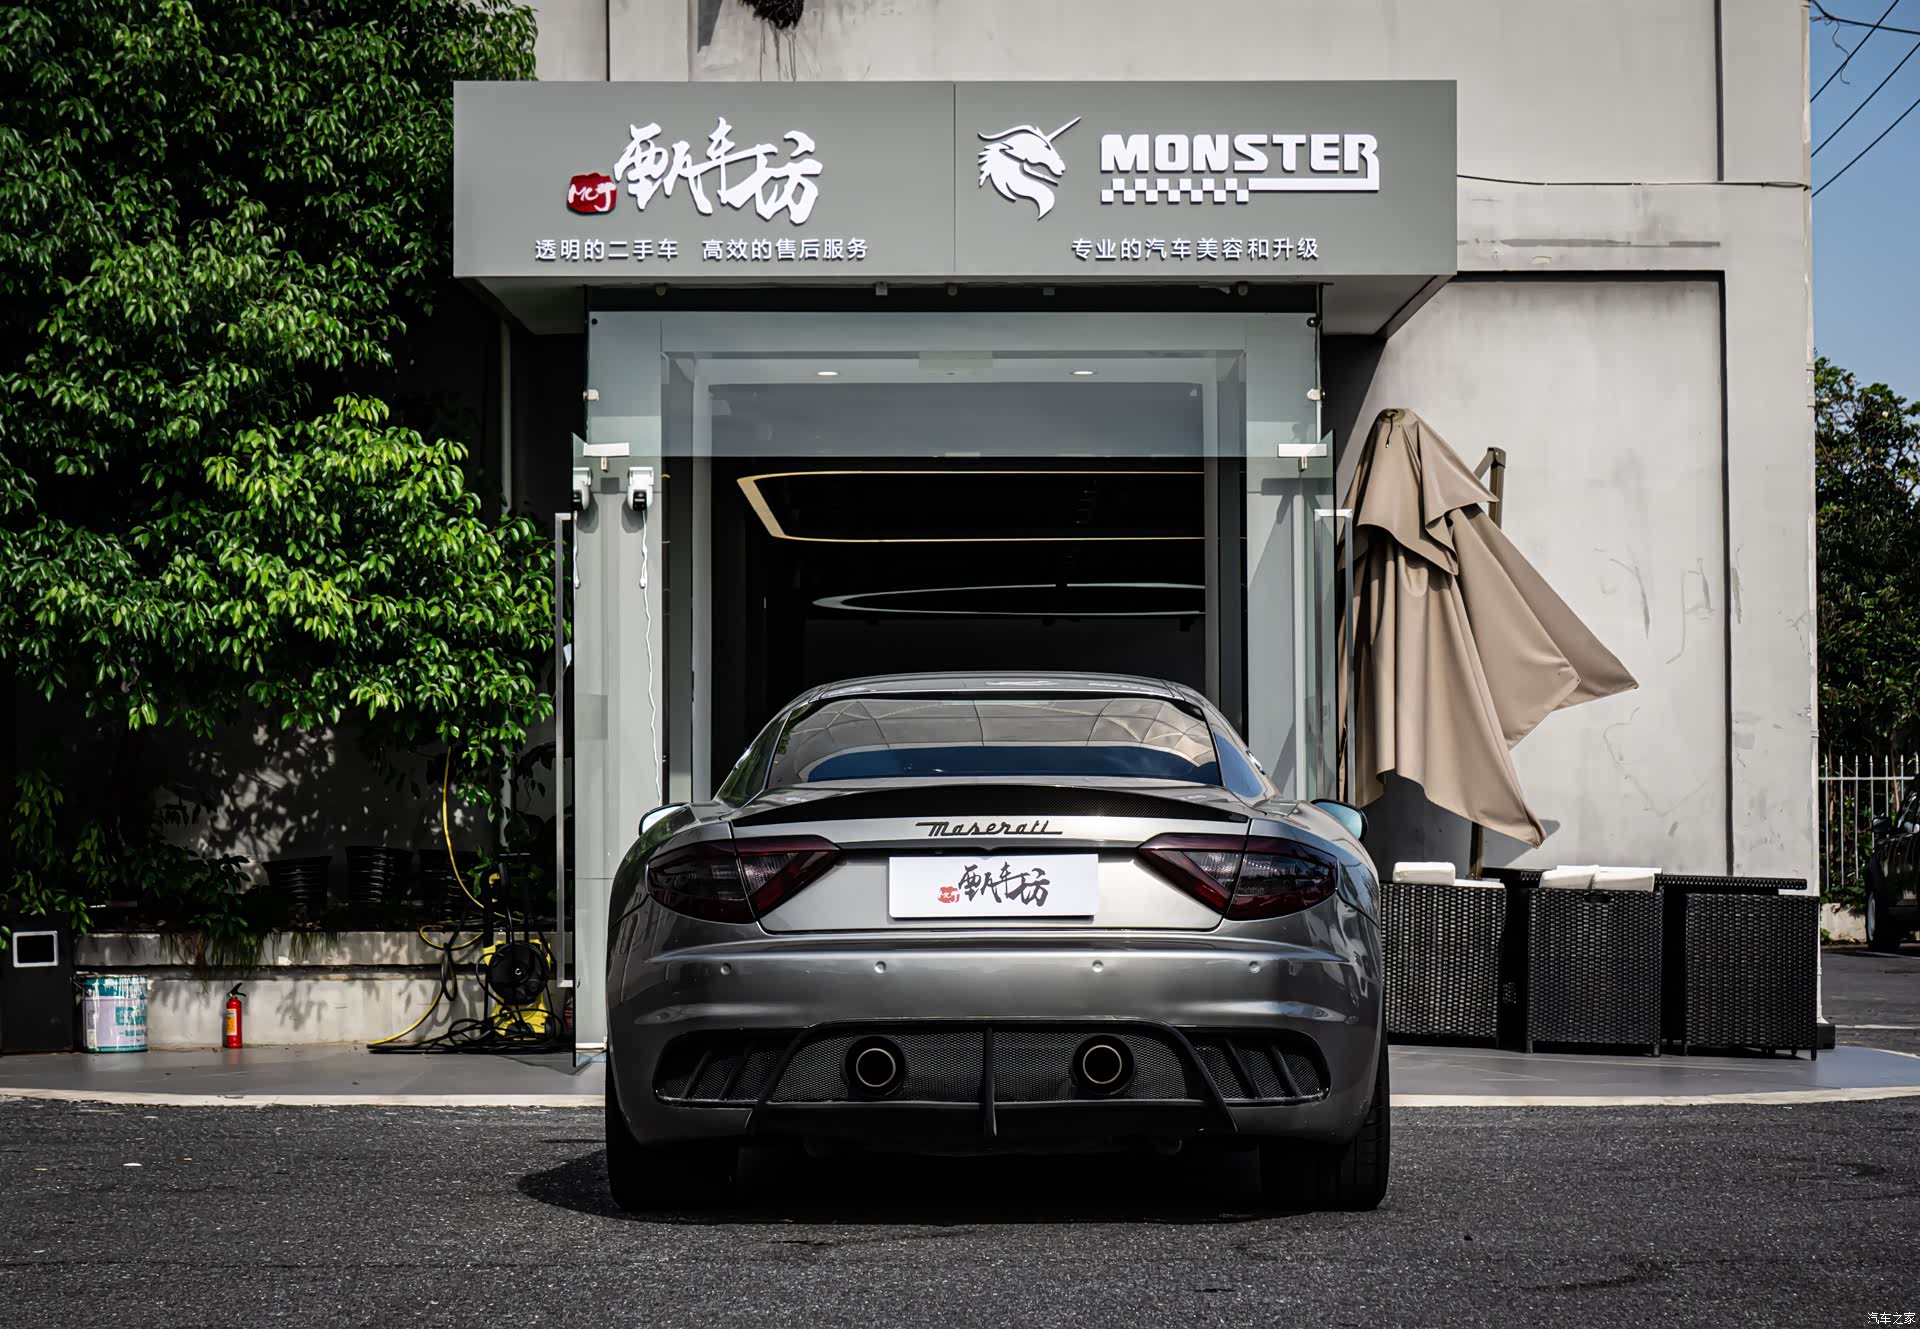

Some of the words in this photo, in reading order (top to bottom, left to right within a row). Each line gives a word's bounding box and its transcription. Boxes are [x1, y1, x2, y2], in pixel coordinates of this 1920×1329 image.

[1102, 134, 1380, 191] MONSTER
[535, 237, 679, 260] 透明的二手车
[702, 236, 869, 260] 高效的售后服务
[1071, 236, 1319, 260] 专业的汽车美容和升级
[915, 820, 1063, 837] Maserati
